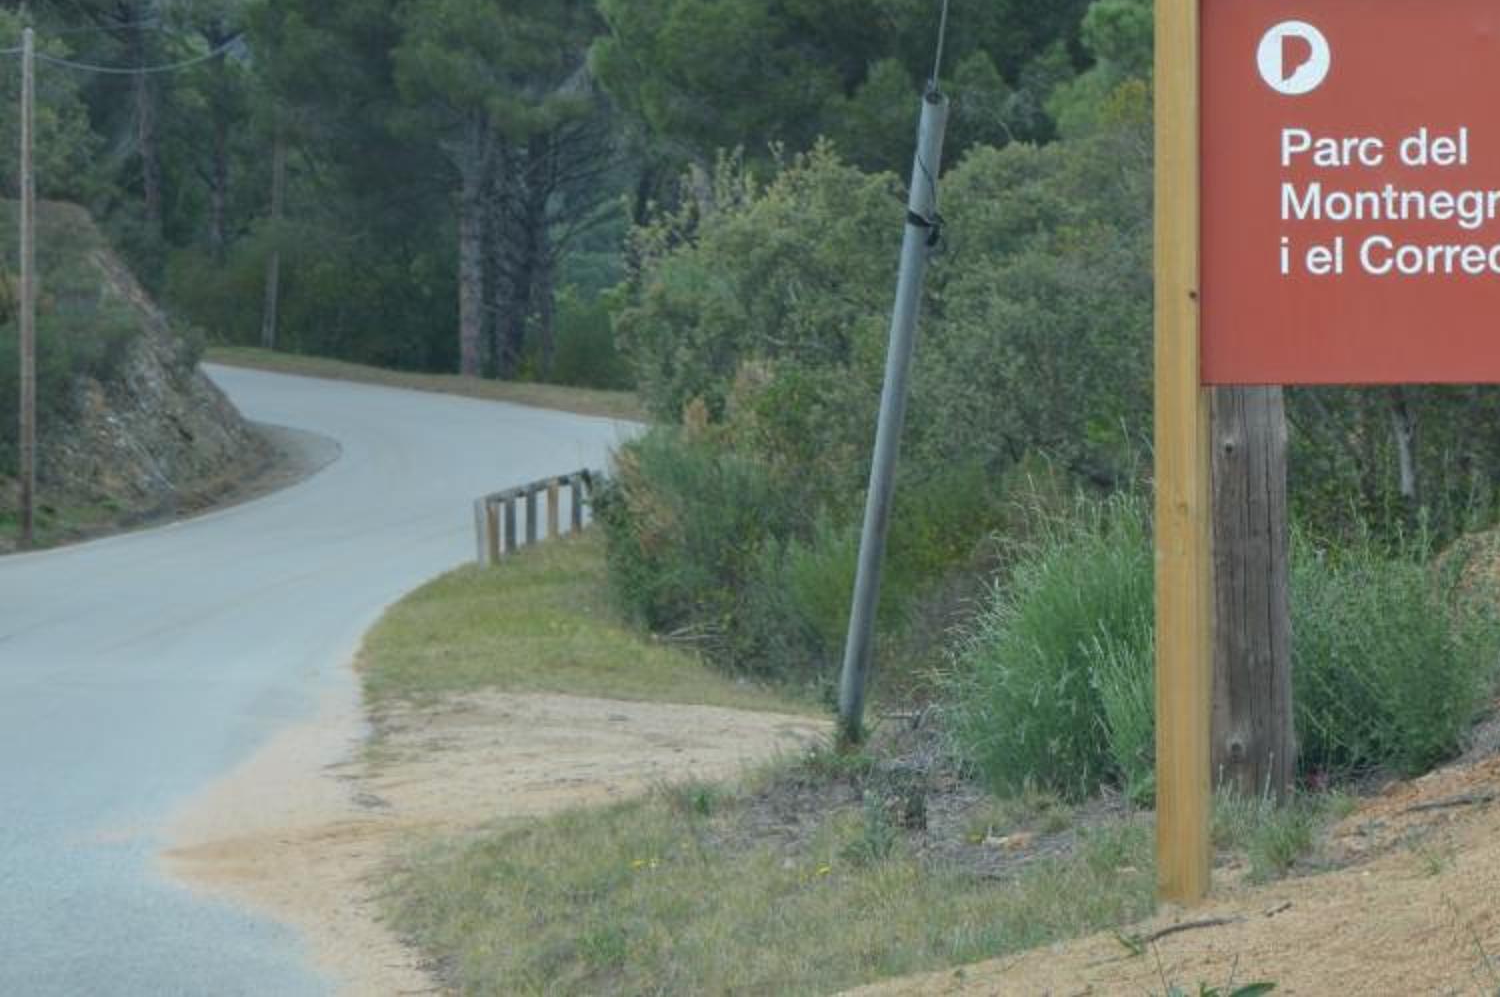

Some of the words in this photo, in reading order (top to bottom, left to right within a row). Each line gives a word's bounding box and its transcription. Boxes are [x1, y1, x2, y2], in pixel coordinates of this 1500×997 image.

[1281, 128, 1383, 166] Parc
[1399, 126, 1469, 166] del
[1280, 236, 1290, 274] i
[1305, 236, 1344, 275] el
